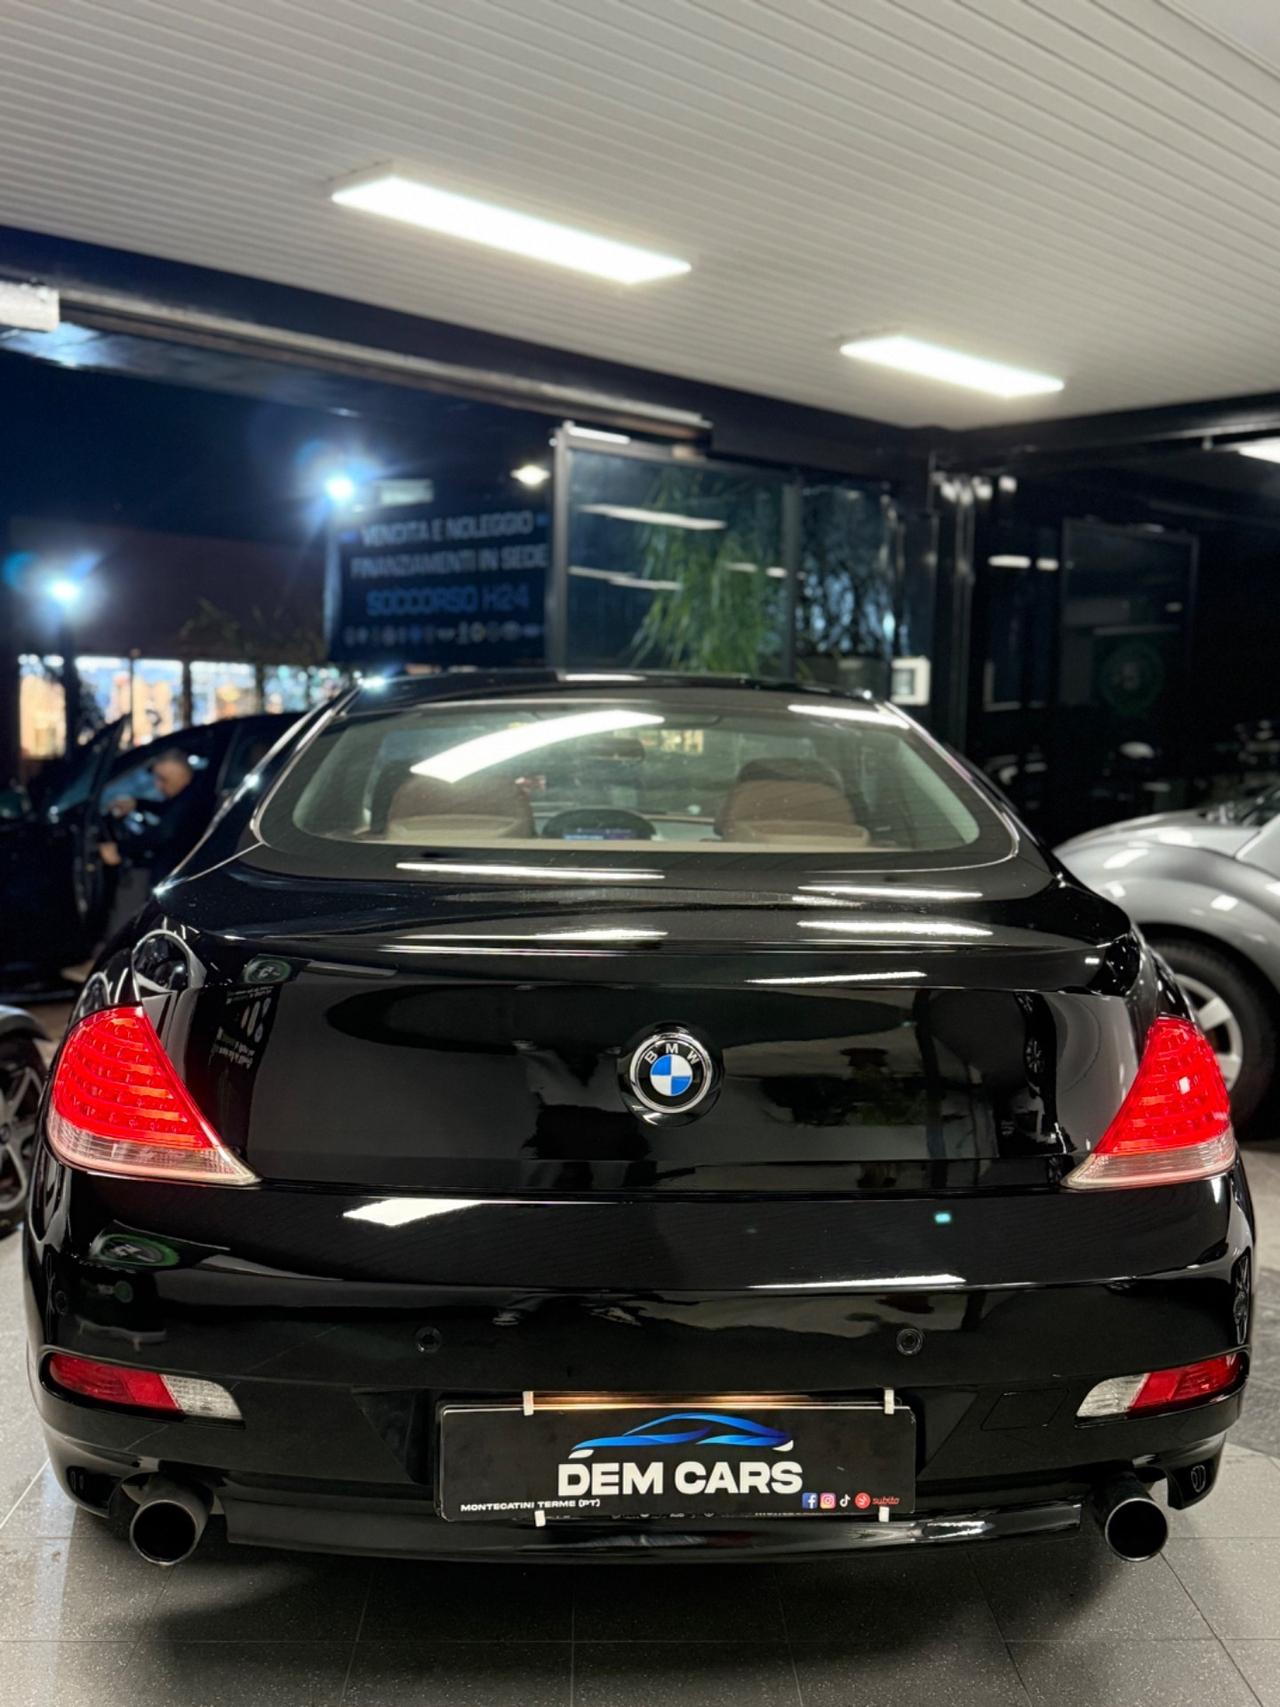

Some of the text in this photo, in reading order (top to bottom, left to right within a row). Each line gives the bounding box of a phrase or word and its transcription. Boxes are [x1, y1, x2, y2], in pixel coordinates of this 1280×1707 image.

[446, 510, 534, 540] NOLEGGIO
[366, 582, 530, 616] SOCCORSO H24
[644, 1043, 700, 1065] BMW
[558, 1461, 803, 1497] DEM CARS
[460, 1499, 601, 1512] MONTECATINI TERME (PT)
[872, 1496, 900, 1505] subito
